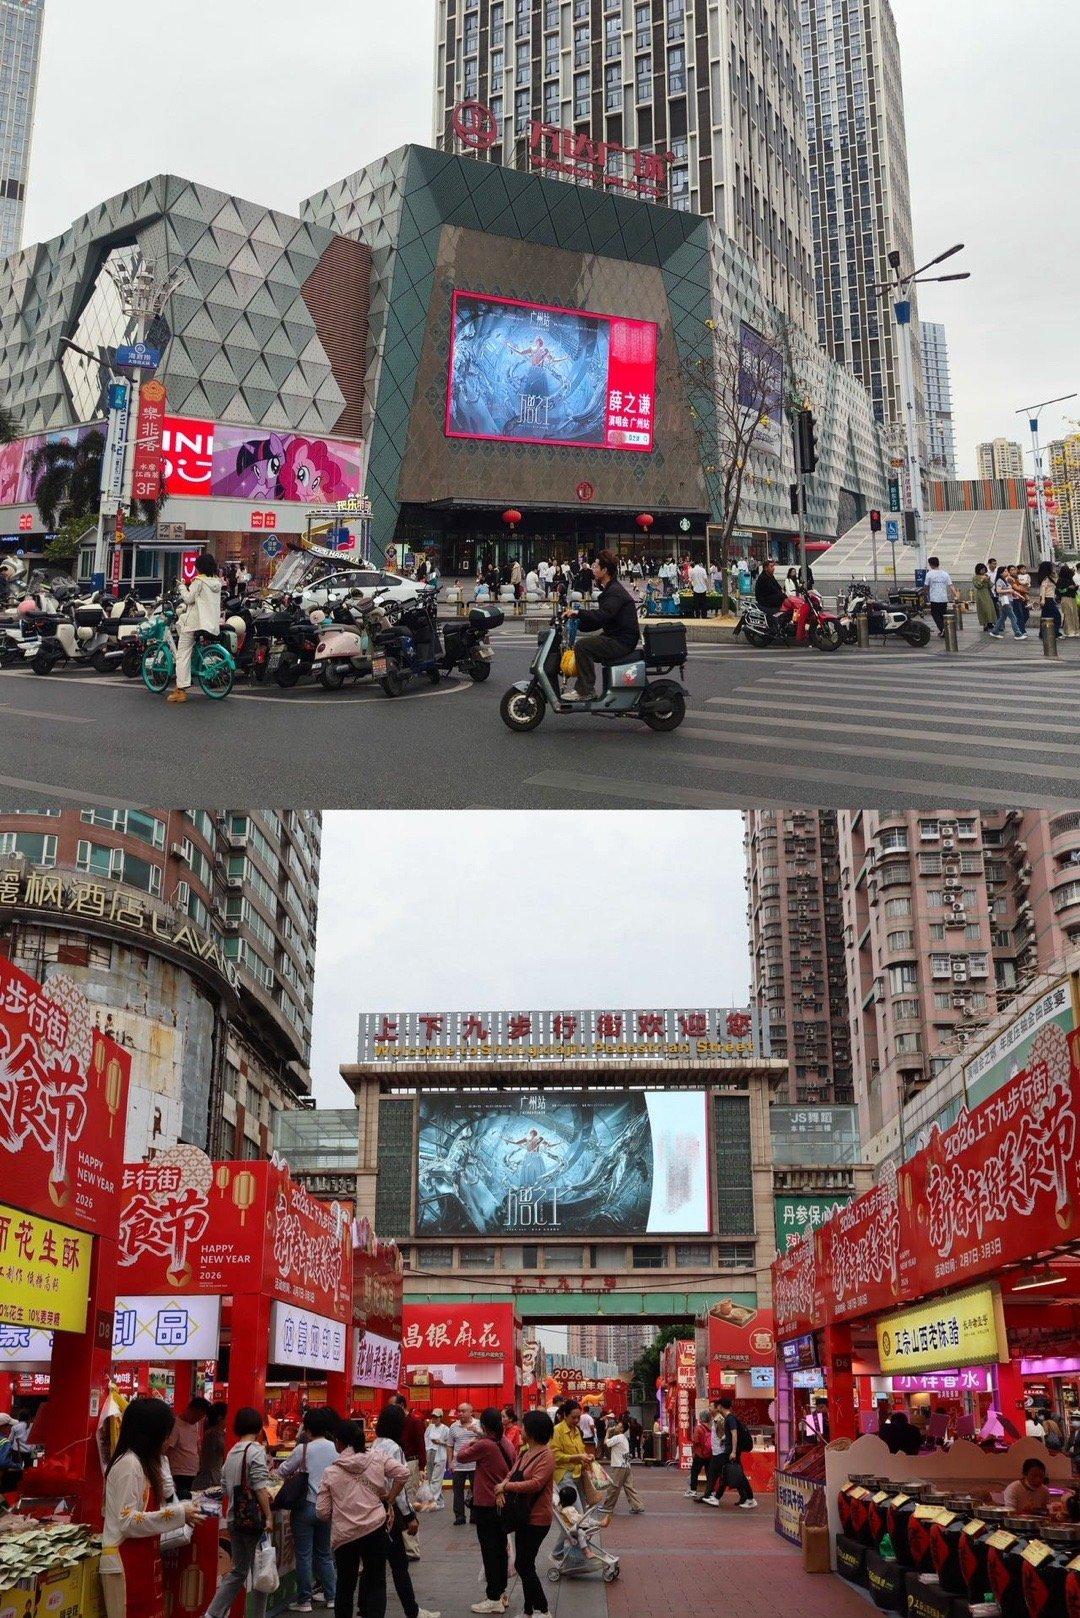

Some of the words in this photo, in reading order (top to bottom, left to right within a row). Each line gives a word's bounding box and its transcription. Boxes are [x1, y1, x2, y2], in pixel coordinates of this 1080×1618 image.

[528, 119, 677, 183] 万达广场
[530, 311, 550, 327] 广州站
[609, 389, 651, 415] 薛之谦
[608, 415, 629, 428] 演唱会
[630, 417, 650, 430] 广州站
[136, 482, 156, 494] 3F
[0, 977, 68, 1049] 步行街
[375, 1012, 752, 1042] 上下九步行街欢迎您
[375, 1045, 455, 1057] Welcome
[460, 1045, 477, 1056] to
[594, 1041, 691, 1055] Pedestrian
[697, 1040, 755, 1053] Street
[0, 1023, 88, 1181] 食节
[520, 1095, 546, 1110] 广州站
[945, 1067, 1047, 1162] 2026上下九步行街
[78, 1150, 104, 1173] HAPPY
[77, 1167, 97, 1185] NEW
[96, 1175, 115, 1194] YEAR
[76, 1192, 93, 1208] 2026
[201, 1244, 234, 1253] HAPPY
[201, 1255, 224, 1264] NEW
[225, 1254, 251, 1264] YEAR
[199, 1271, 222, 1280] 2026
[511, 1275, 617, 1290] 上下九广场
[402, 1321, 501, 1349] 昌银麻花
[894, 1316, 959, 1355] 正宗山西老陈醋
[554, 1369, 582, 1380] 2026
